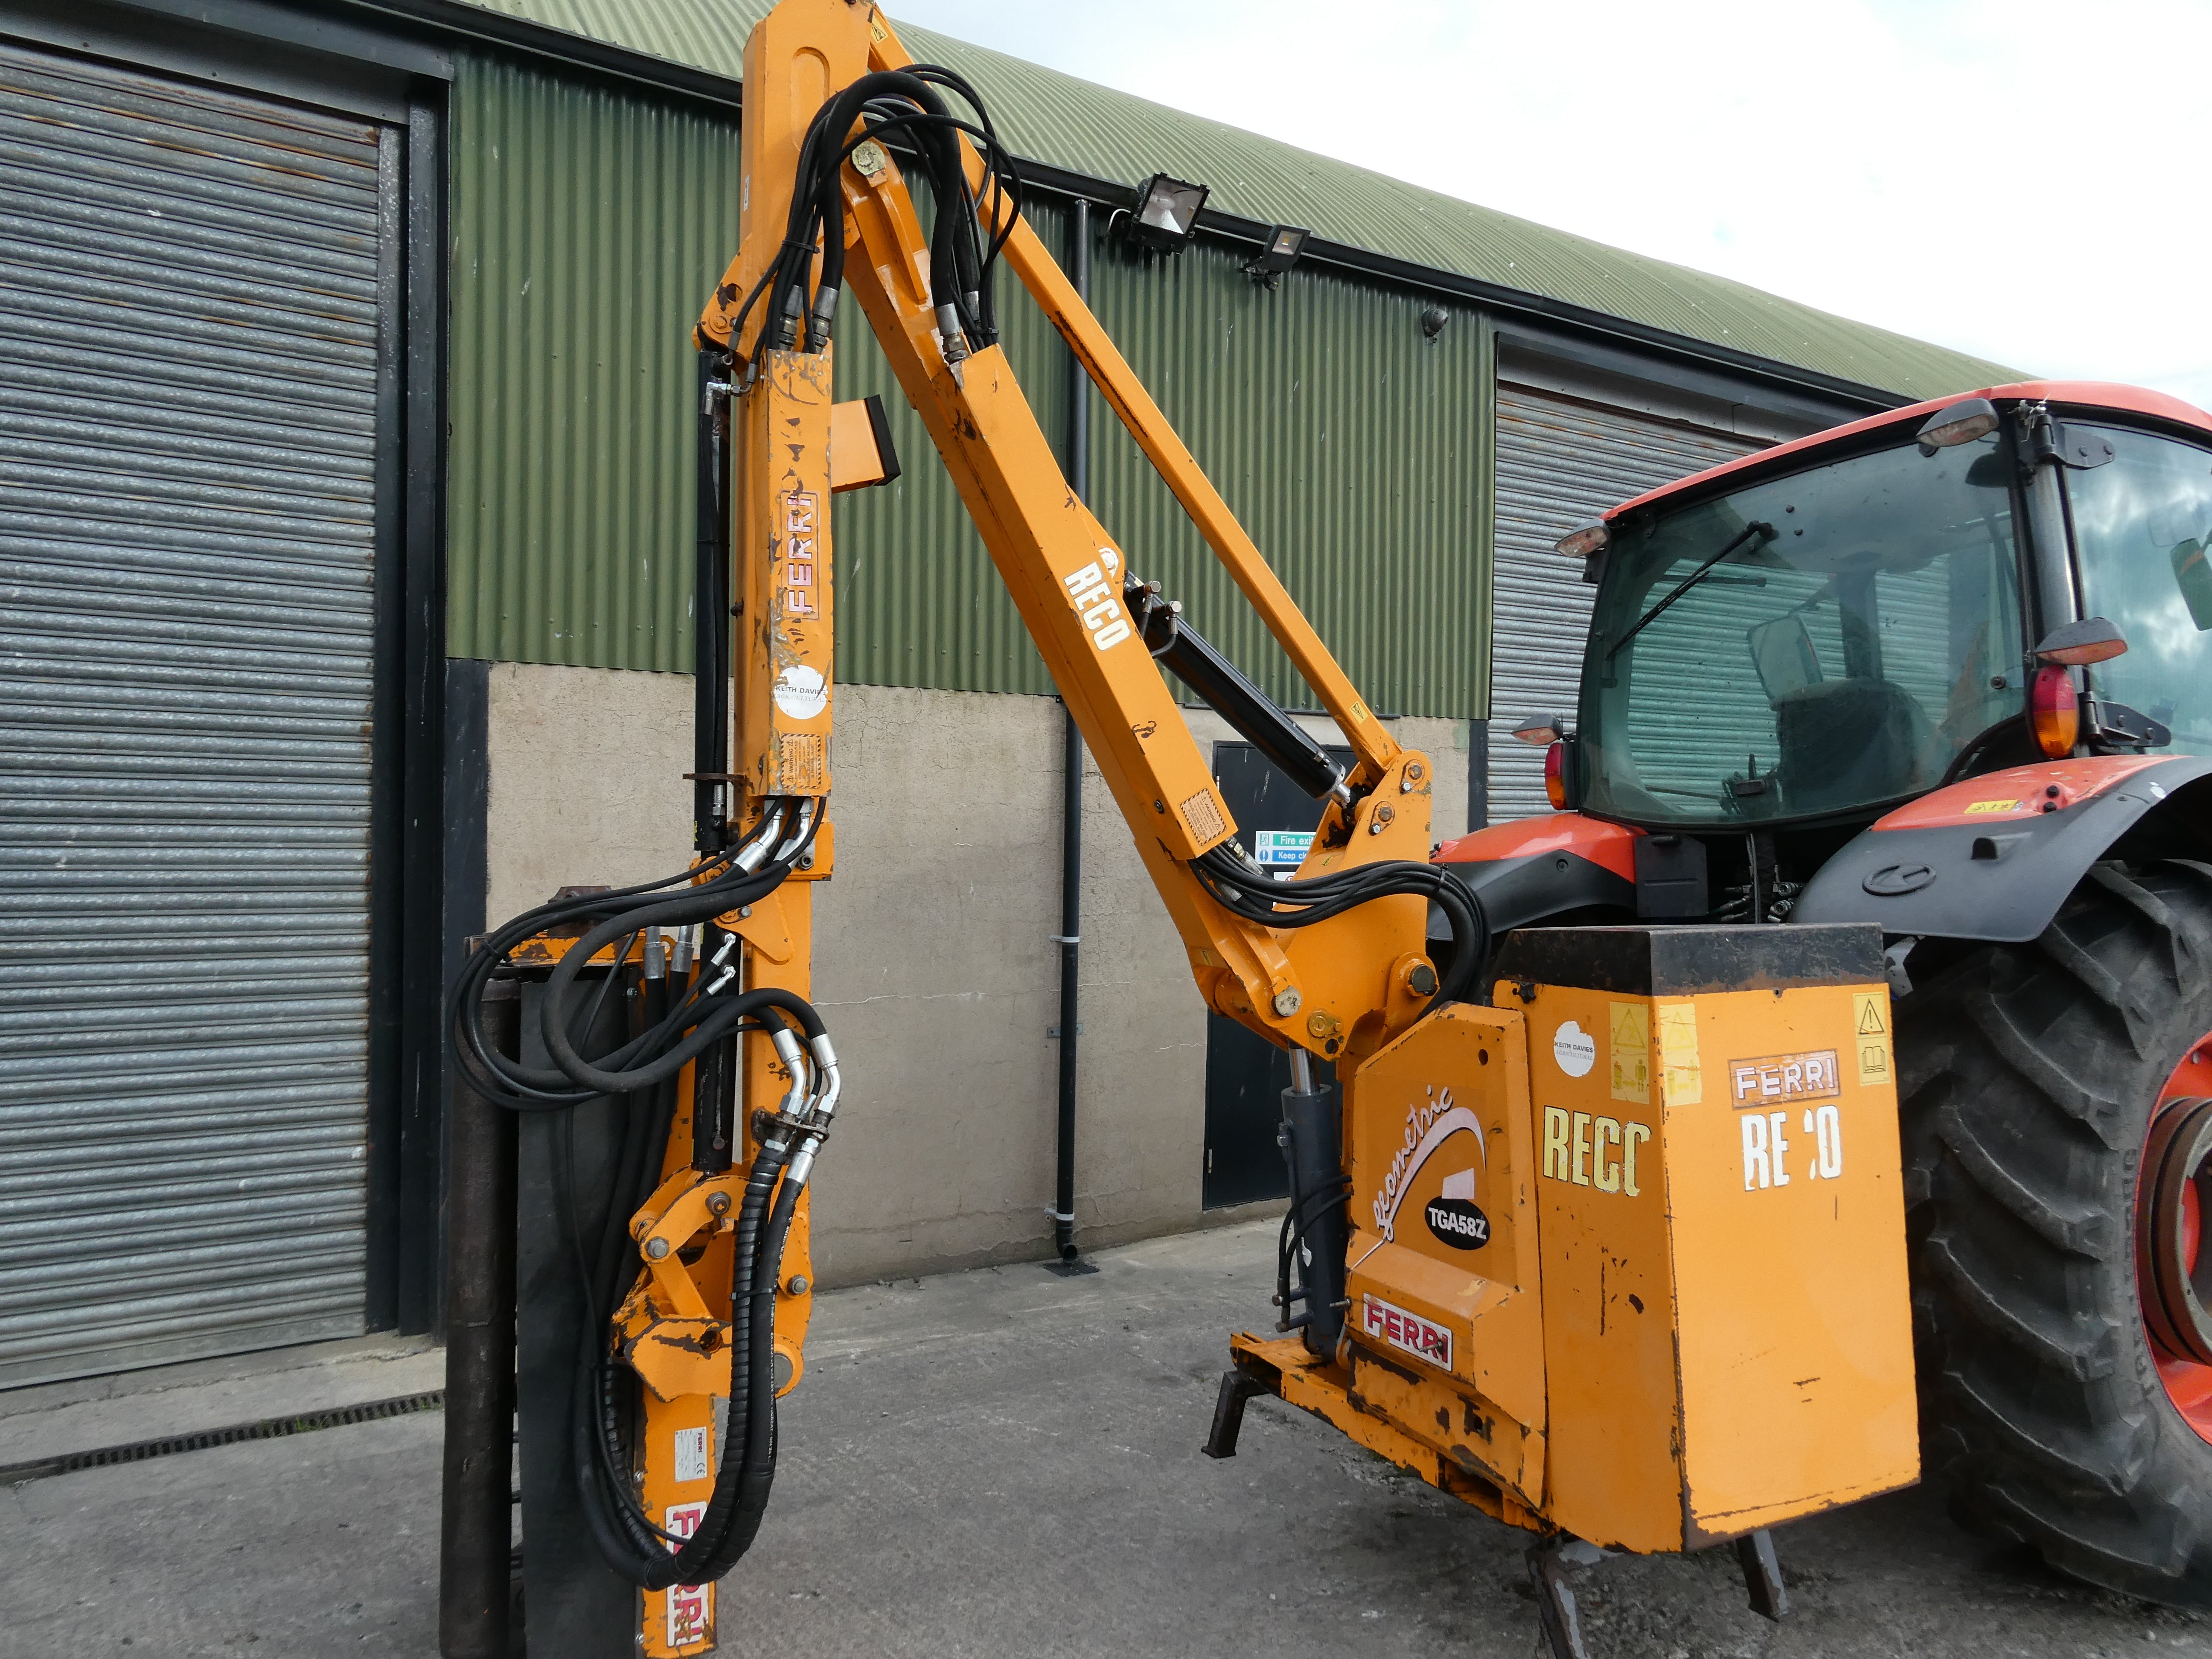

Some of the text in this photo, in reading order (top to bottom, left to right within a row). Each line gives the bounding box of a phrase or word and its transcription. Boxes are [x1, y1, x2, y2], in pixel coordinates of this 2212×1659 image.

[787, 496, 812, 613] FERRI
[1064, 562, 1131, 651] RECO
[1205, 803, 1216, 823] WARNING
[1278, 851, 1295, 860] Keep
[1281, 836, 1295, 844] Fire
[1573, 1044, 1593, 1053] DAVIES
[1735, 1058, 1835, 1100] FERRI
[1741, 1104, 1842, 1191] REO
[1428, 1207, 1487, 1240] TGA58Z
[1368, 1302, 1448, 1364] FERRI
[673, 1509, 701, 1639] FRI
